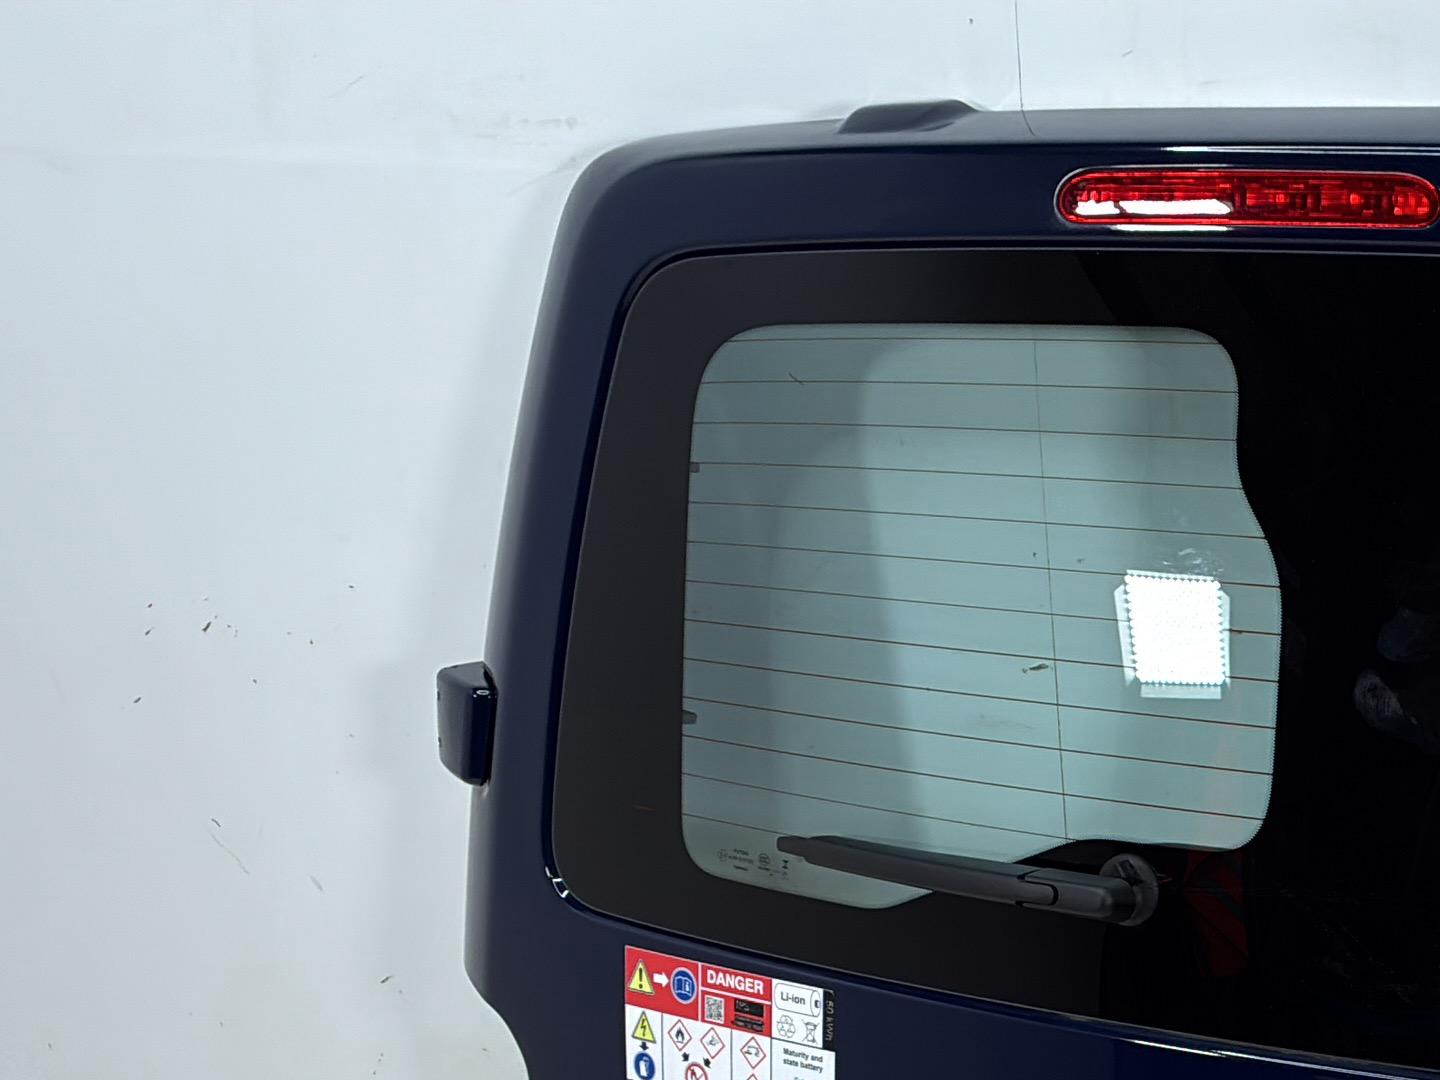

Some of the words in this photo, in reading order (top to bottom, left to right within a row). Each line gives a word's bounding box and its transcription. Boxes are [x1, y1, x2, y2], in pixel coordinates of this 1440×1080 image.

[706, 969, 764, 995] DANGER
[781, 991, 806, 1005] Li-ion
[783, 1048, 809, 1061] Maturity
[783, 1059, 799, 1067] state
[800, 1061, 823, 1074] battery
